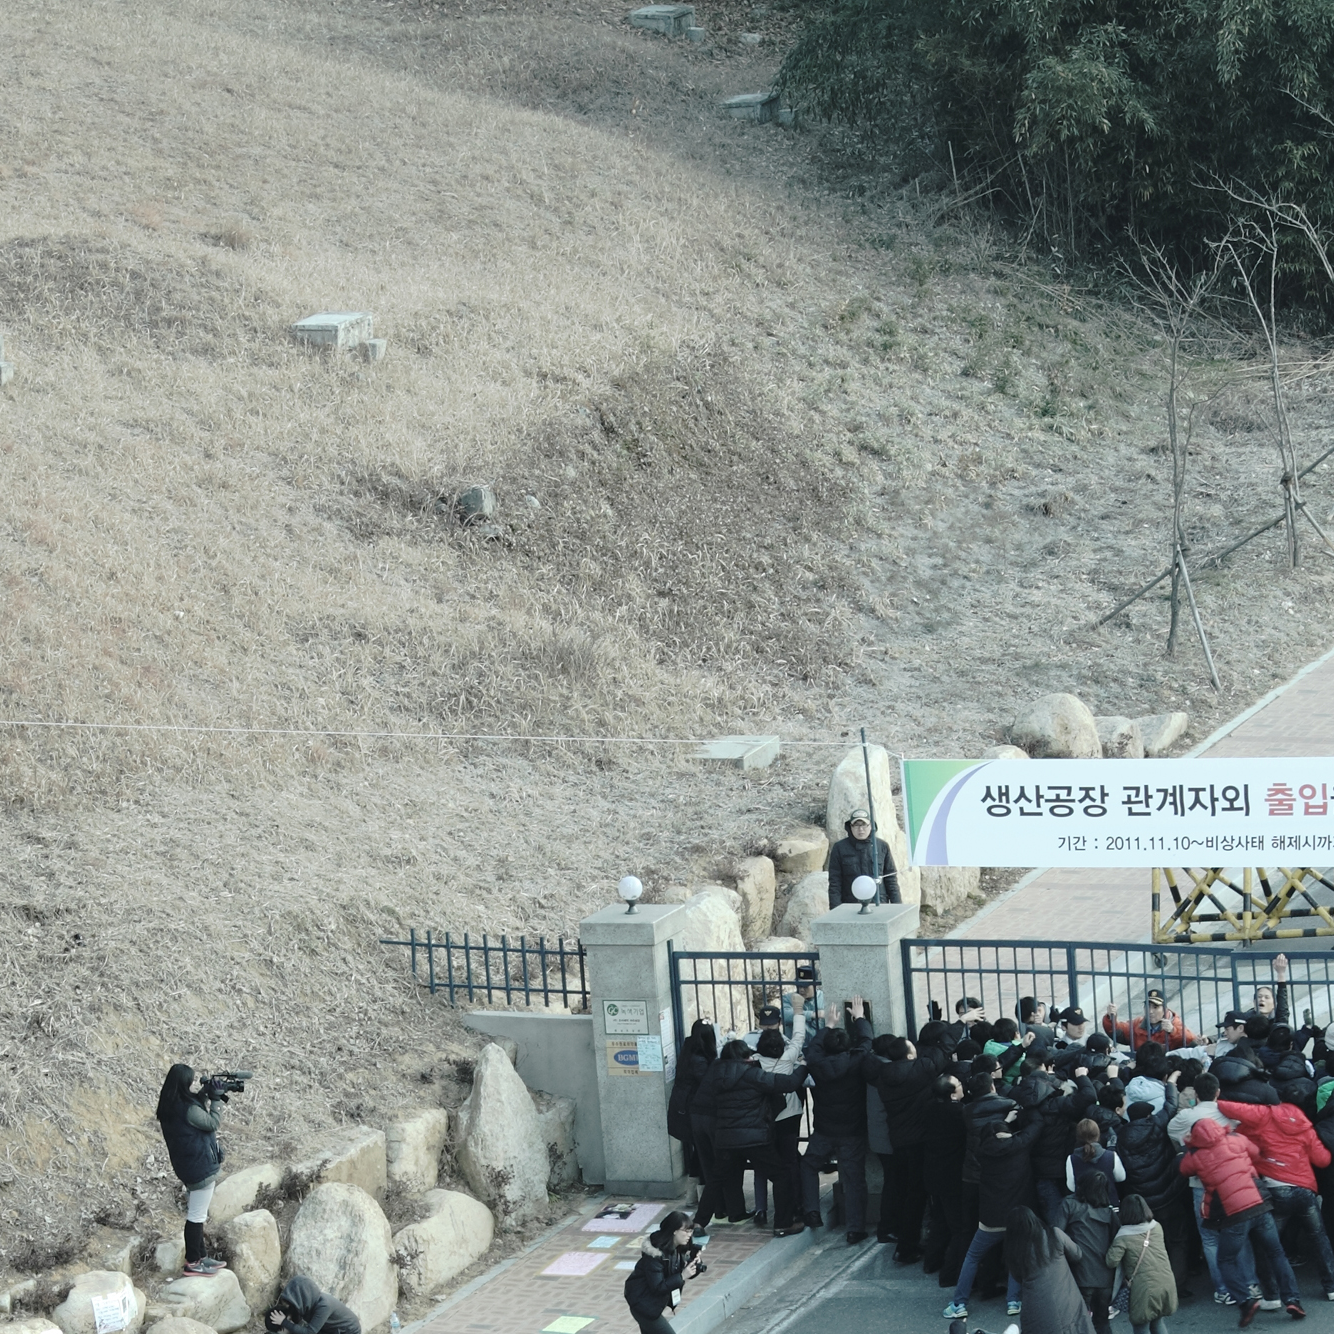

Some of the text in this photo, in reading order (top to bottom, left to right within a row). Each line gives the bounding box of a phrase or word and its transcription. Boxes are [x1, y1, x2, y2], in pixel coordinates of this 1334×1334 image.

[980, 784, 1110, 818] 생산공장
[1121, 783, 1251, 817] 관계자외
[1058, 835, 1087, 851] 기간
